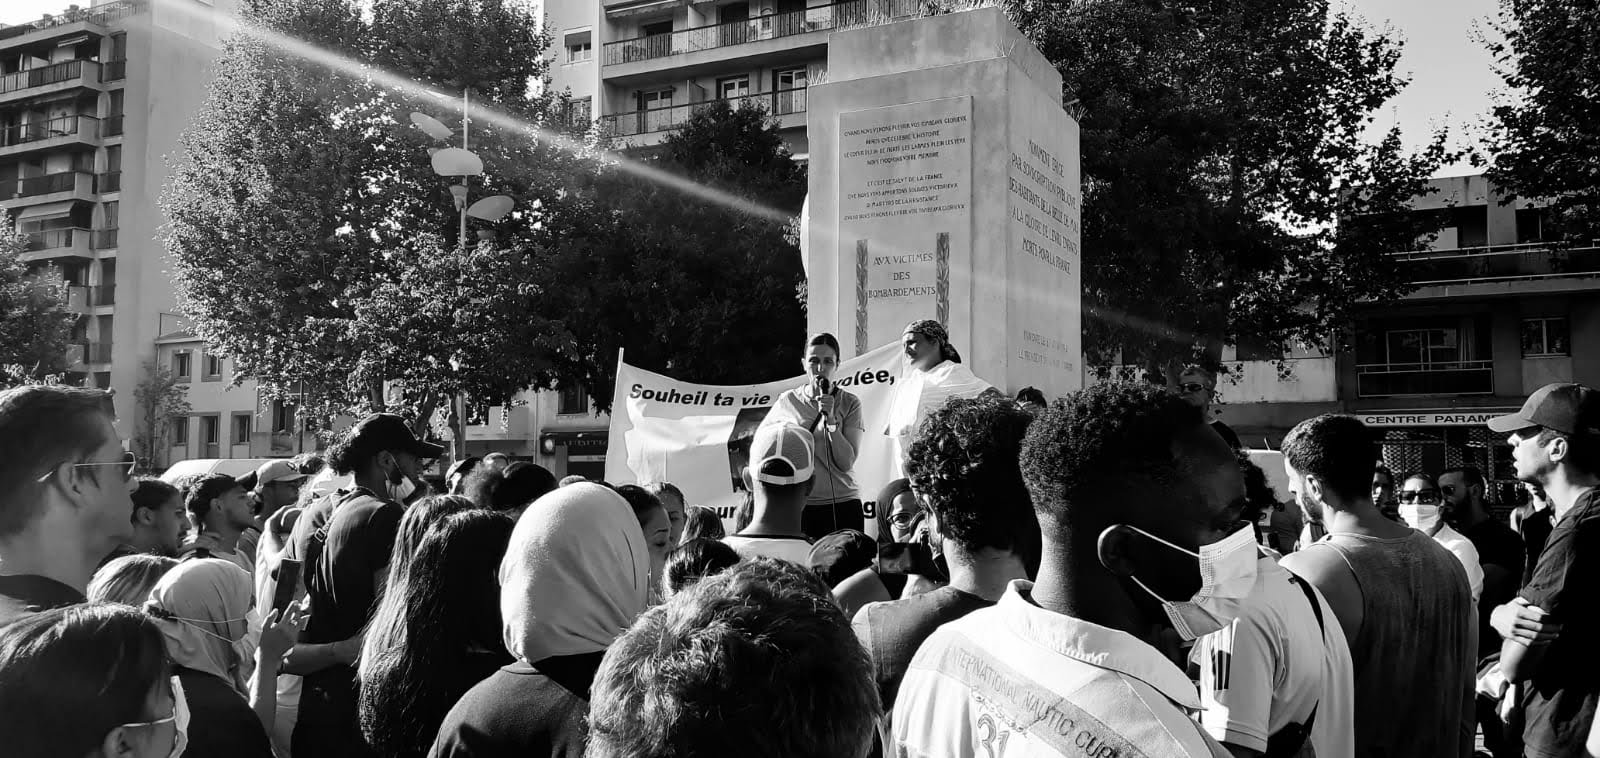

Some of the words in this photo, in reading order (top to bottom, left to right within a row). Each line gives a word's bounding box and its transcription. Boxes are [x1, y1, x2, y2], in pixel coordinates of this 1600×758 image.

[893, 252, 933, 264] VICTIMES
[893, 271, 911, 280] DES
[868, 286, 936, 298] BOMBARDEMENTS
[629, 383, 708, 406] Souheil
[713, 391, 734, 407] ta
[740, 392, 771, 407] vie
[1365, 415, 1426, 424] CENTRE
[1434, 414, 1504, 423] PARAM
[1022, 690, 1075, 737] NAUTIC
